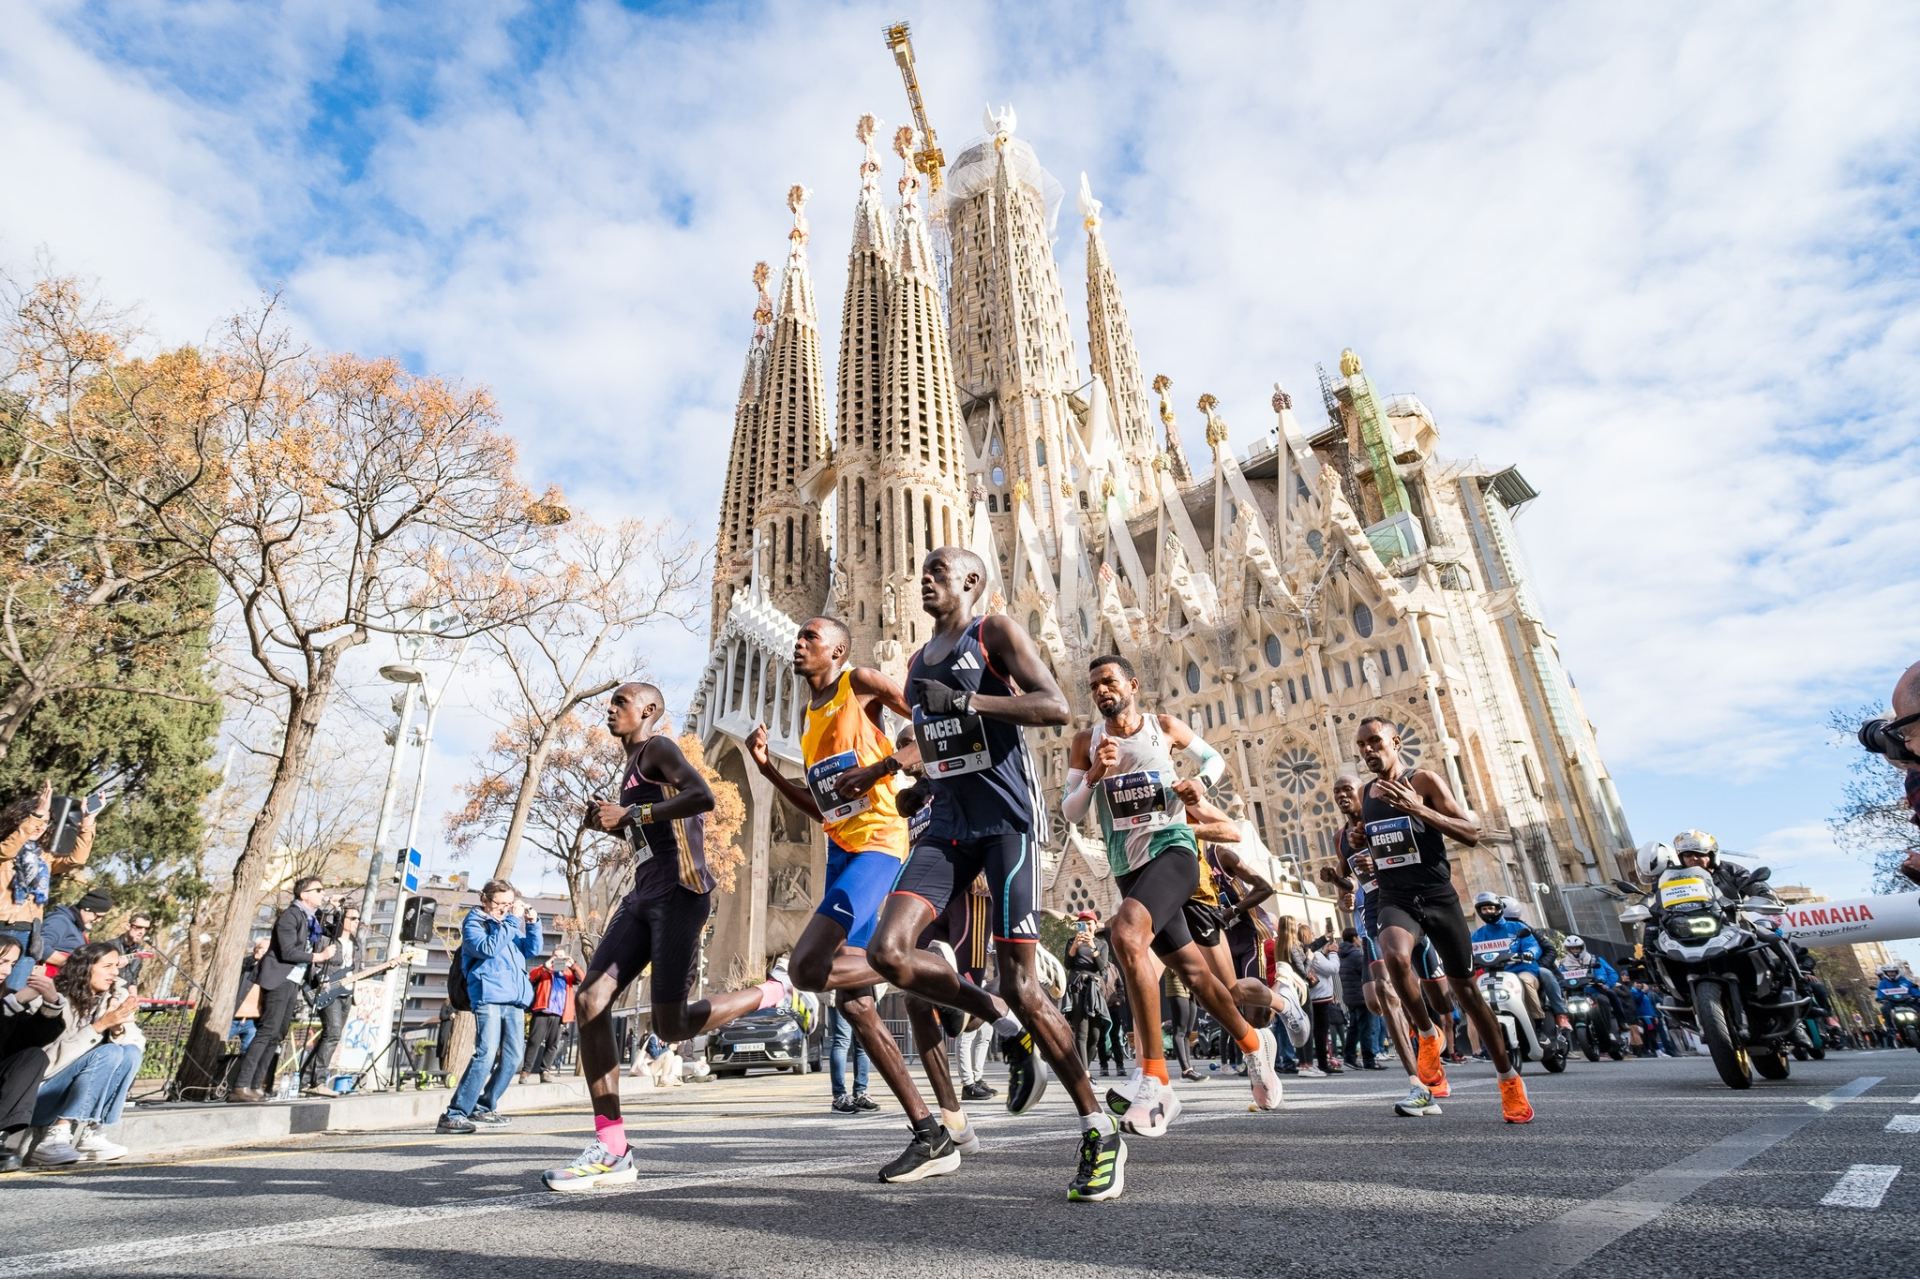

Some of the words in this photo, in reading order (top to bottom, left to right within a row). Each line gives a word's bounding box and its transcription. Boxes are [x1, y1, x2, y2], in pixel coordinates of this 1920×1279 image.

[924, 718, 962, 741] PACER
[937, 740, 948, 752] 27
[820, 760, 840, 773] ZURICH
[817, 772, 844, 794] PACE
[831, 791, 838, 801] 25
[1113, 785, 1156, 803] TADESSE
[1133, 801, 1139, 810] 2
[1785, 905, 1874, 927] YAMAHA
[1818, 927, 1840, 938] Your
[1842, 924, 1869, 933] Heart
[1479, 941, 1507, 950] YAMAHA
